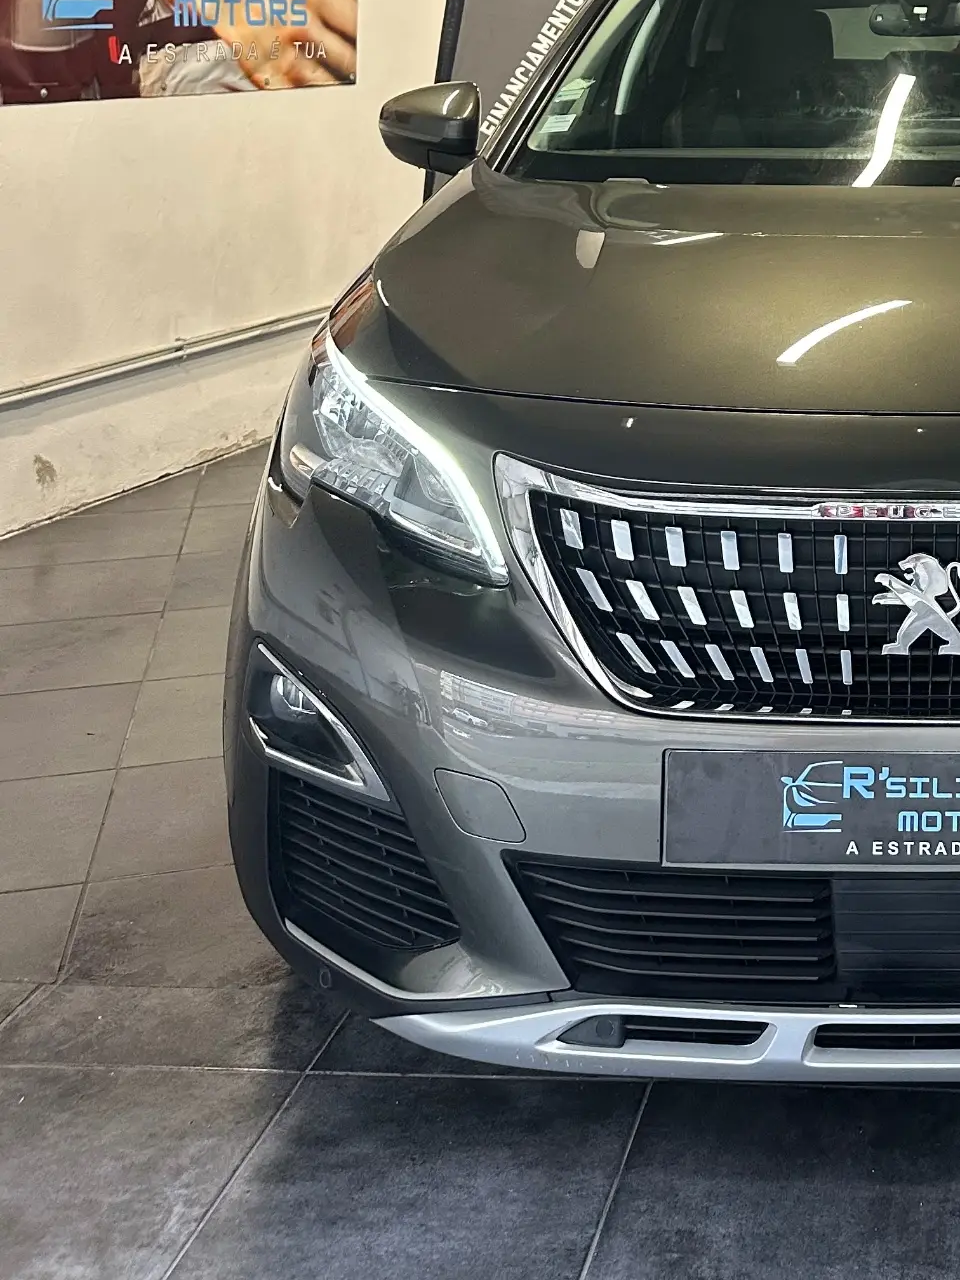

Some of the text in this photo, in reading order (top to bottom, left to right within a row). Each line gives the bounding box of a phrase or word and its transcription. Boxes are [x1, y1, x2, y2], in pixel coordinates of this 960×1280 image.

[118, 43, 133, 65] A
[146, 41, 259, 63] ESTRADA
[293, 40, 328, 60] TUA
[845, 840, 859, 856] A
